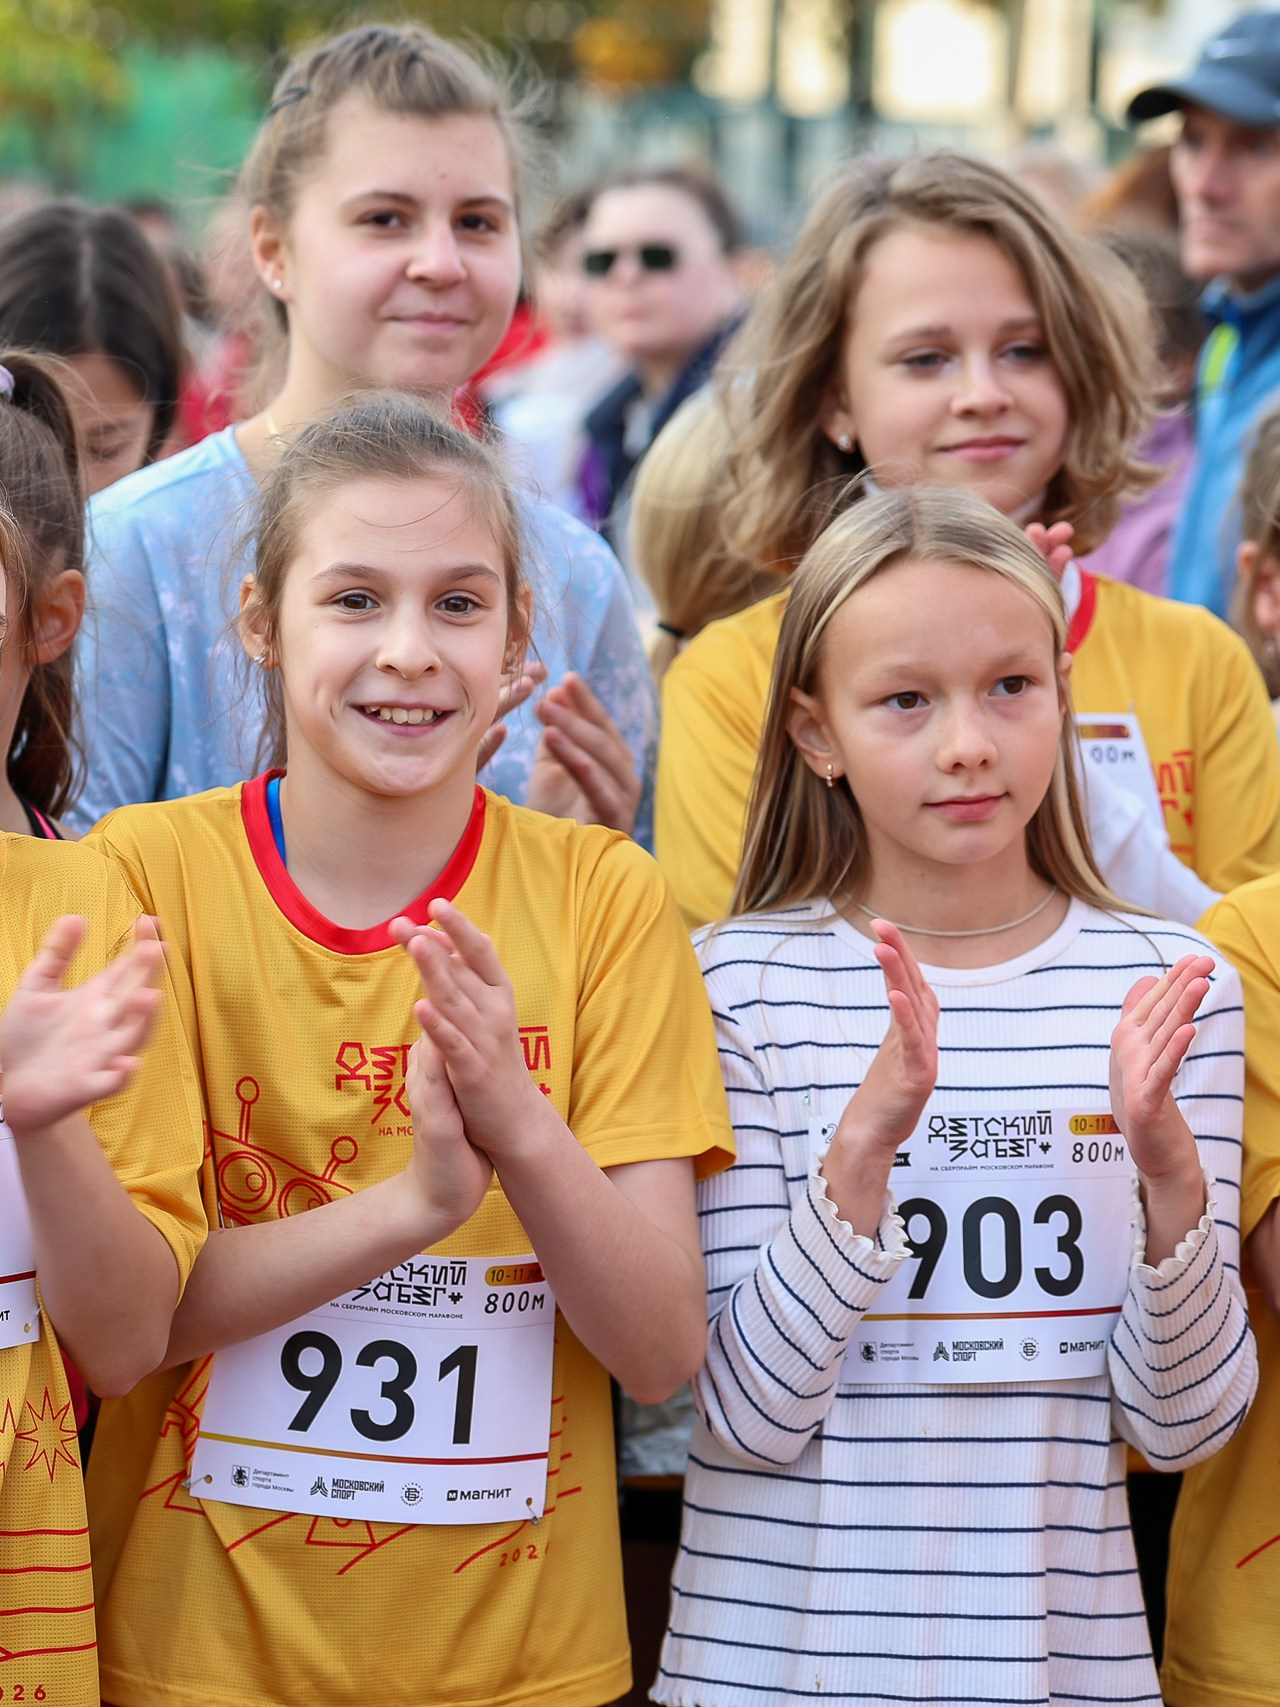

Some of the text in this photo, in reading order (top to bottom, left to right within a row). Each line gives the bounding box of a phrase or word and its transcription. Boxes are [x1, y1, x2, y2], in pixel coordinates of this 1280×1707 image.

[895, 1194, 1085, 1300] 903
[341, 1303, 379, 1313] СБЕРПРАЙМ
[380, 1307, 427, 1318] МОСКОВСКОМ
[952, 1337, 1004, 1351] МОСКОВСКИЙ
[952, 1351, 977, 1362] СПОРТ
[279, 1330, 479, 1445] 931
[332, 1477, 385, 1493] МОСКОВСКИЙ
[331, 1488, 356, 1501] СПОРТ
[499, 1544, 549, 1567] 202
